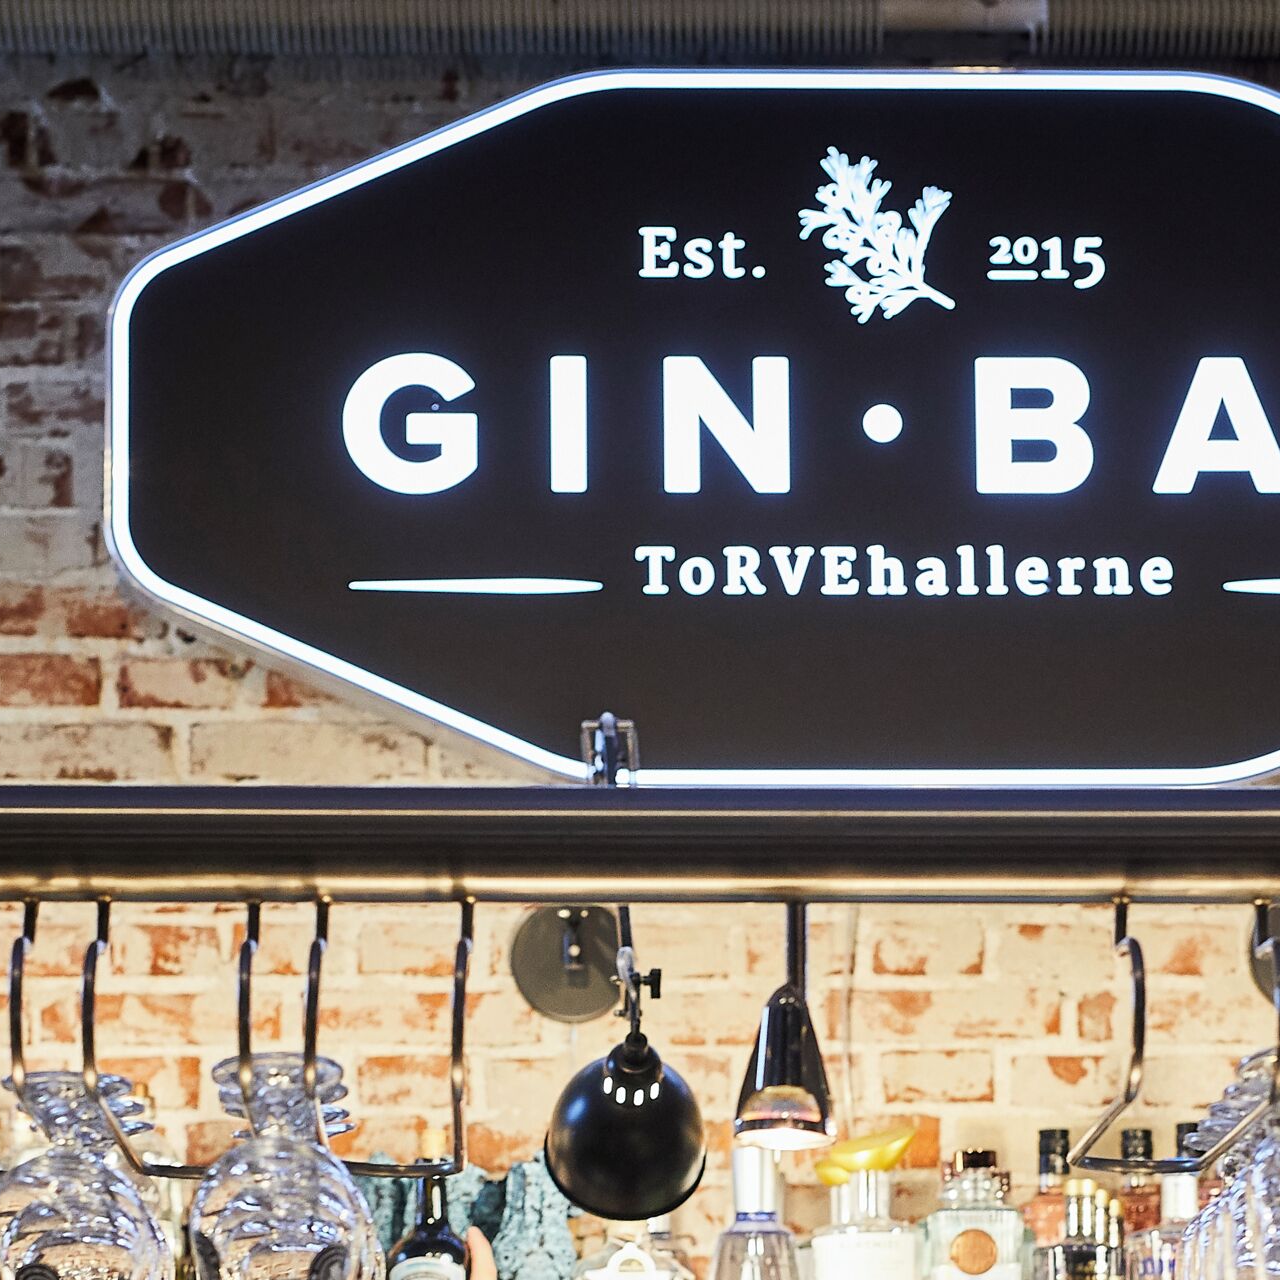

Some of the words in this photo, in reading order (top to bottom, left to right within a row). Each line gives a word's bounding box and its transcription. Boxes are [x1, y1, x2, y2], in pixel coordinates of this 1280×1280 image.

[639, 227, 765, 278] Est.
[987, 236, 1105, 289] 2015
[343, 353, 790, 494] GIN
[635, 545, 1173, 595] ToRVEhallerne
